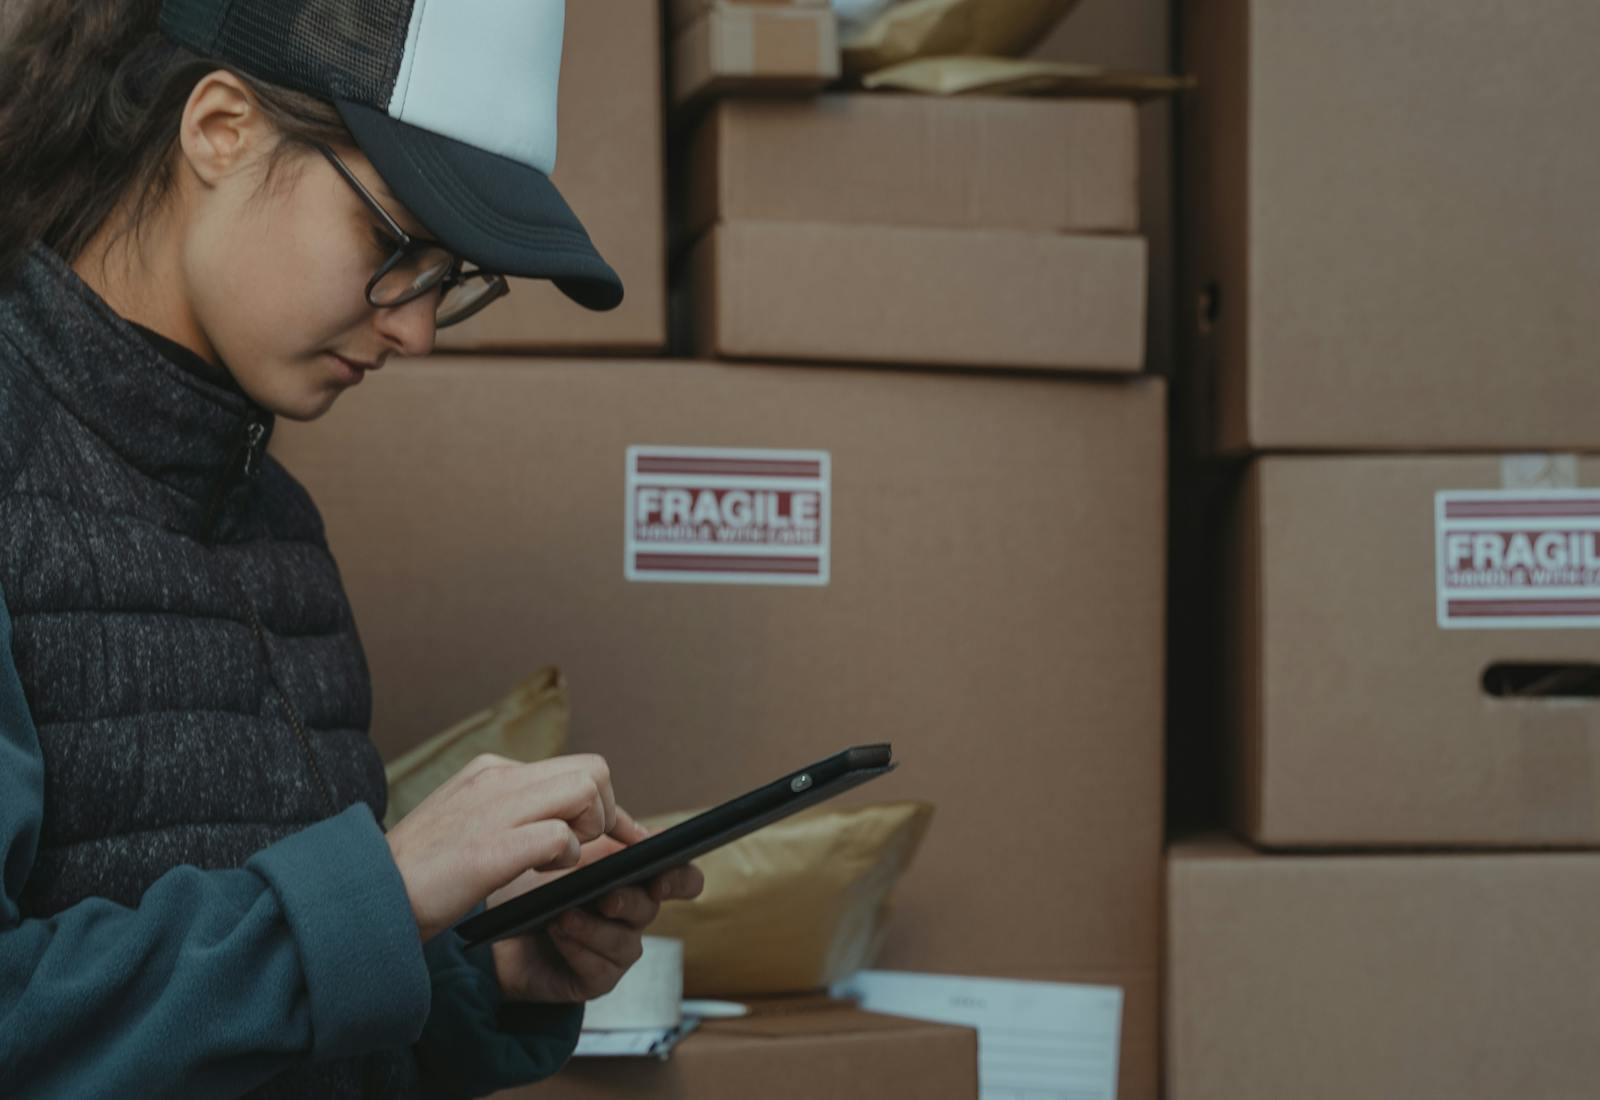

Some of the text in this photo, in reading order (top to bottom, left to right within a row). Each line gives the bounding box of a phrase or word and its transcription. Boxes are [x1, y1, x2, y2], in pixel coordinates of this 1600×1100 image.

[637, 488, 818, 528] FRAGILE
[718, 526, 766, 543] WITH
[1448, 531, 1600, 569] FRAGIL
